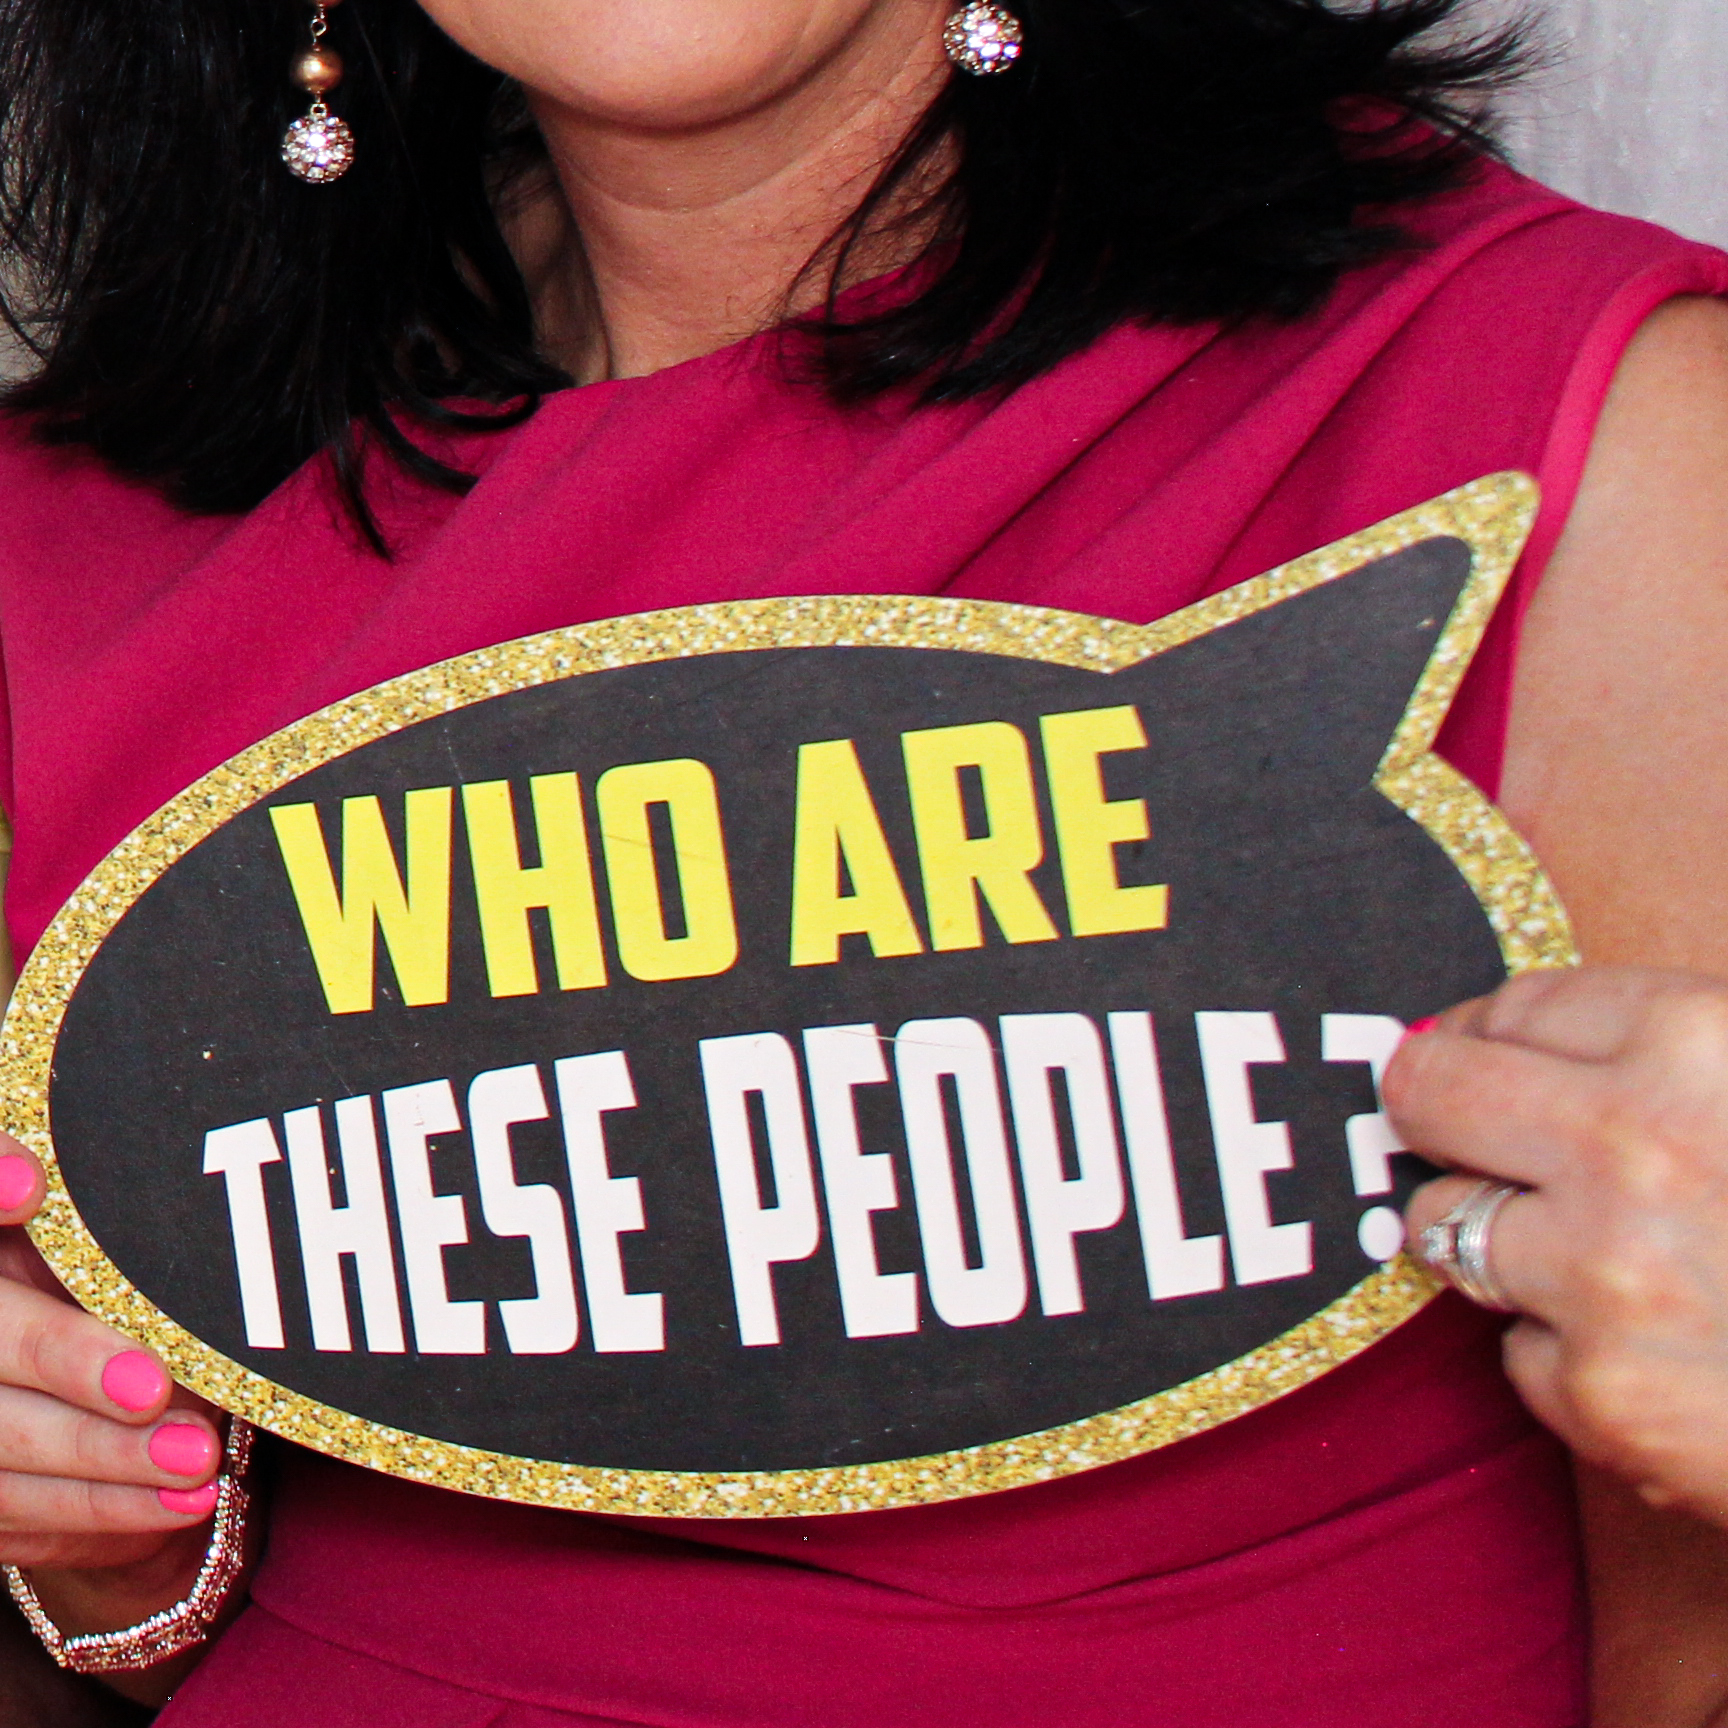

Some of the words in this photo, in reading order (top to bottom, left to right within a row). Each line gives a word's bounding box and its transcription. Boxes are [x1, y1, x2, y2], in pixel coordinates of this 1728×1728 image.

[270, 757, 738, 1014] WHO
[790, 704, 1169, 967] ARE
[202, 1049, 664, 1355] THESE
